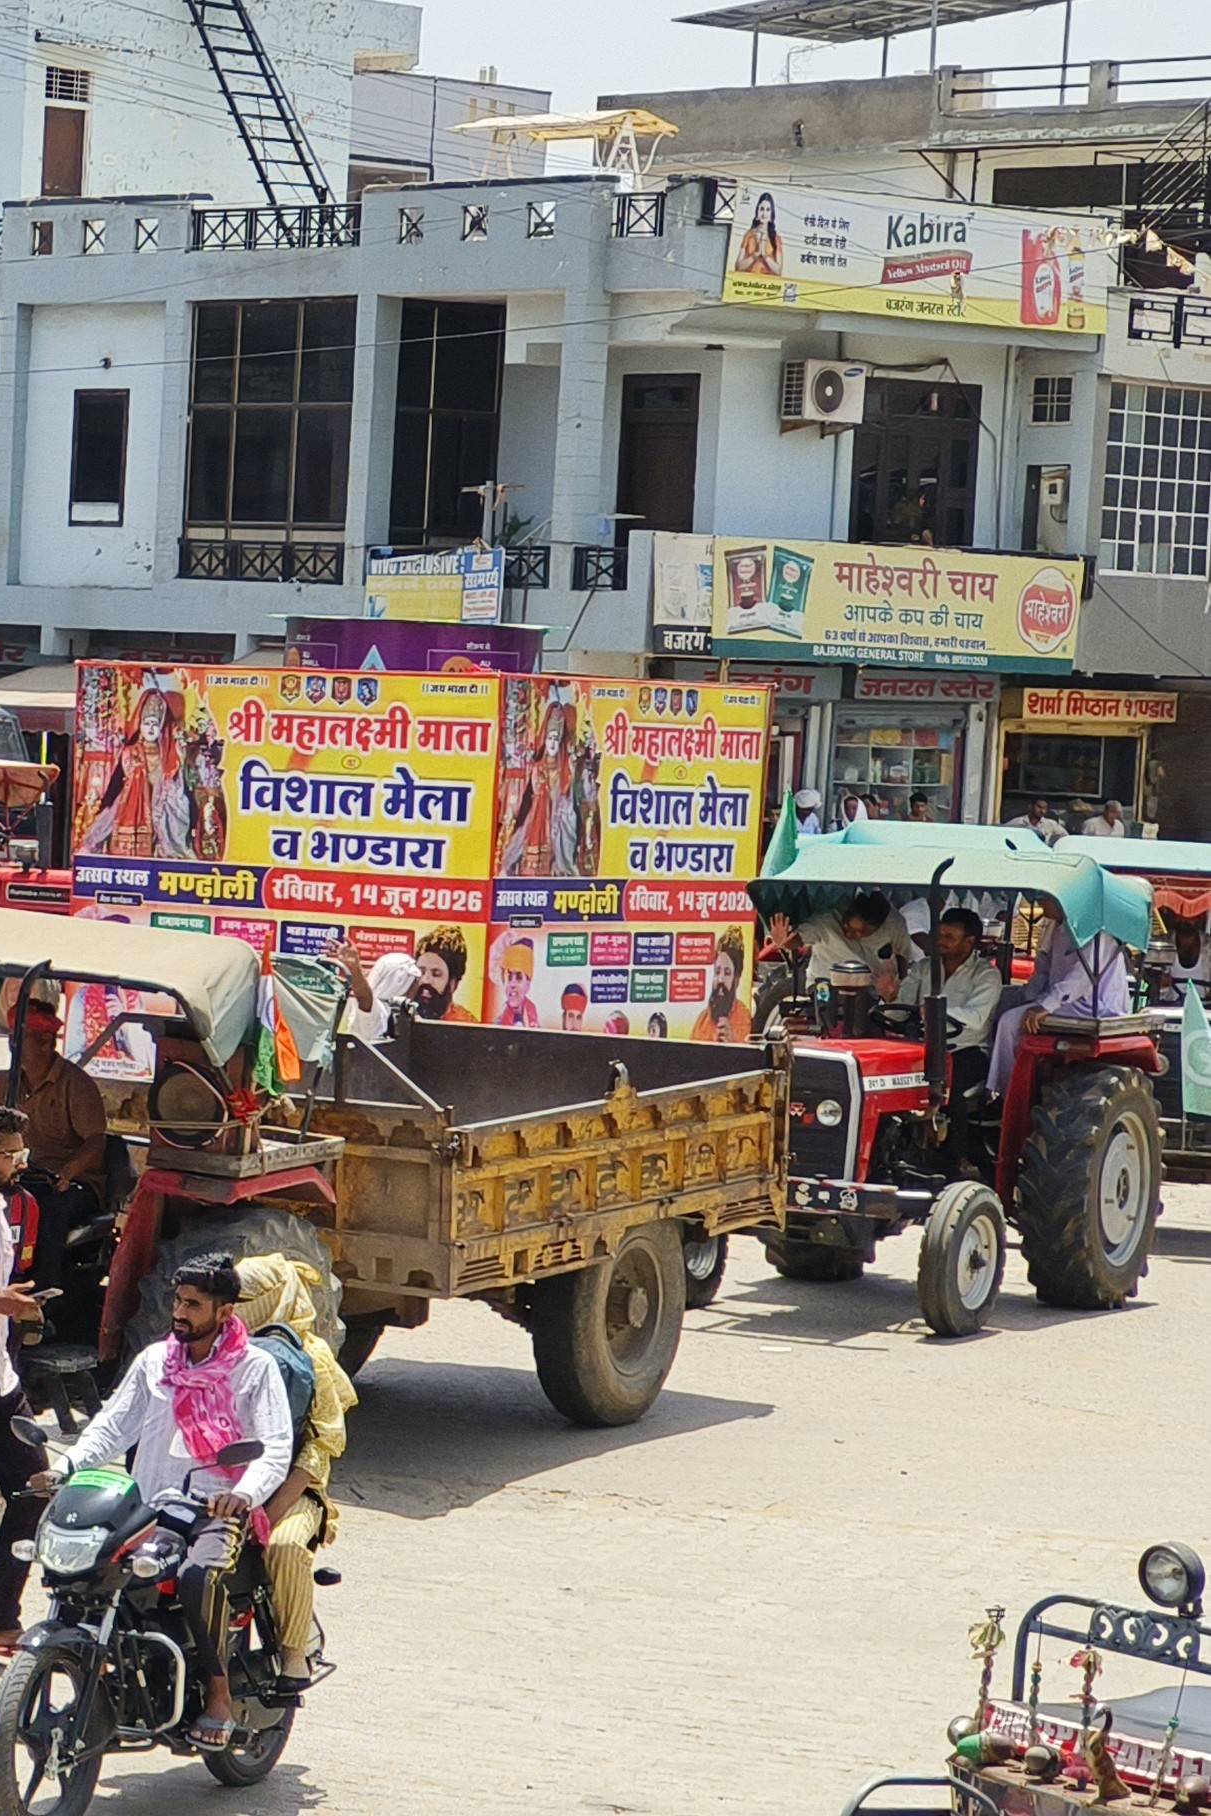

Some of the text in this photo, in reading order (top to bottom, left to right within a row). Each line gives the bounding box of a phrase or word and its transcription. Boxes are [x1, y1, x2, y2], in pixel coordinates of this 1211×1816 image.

[886, 212, 967, 250] Kabira
[887, 259, 967, 280] Yellow Mustard Oil
[885, 297, 966, 317] बजरंग जनरल स्टो
[371, 558, 398, 575] VIVO
[834, 552, 998, 603] माहेश्वरी चाय
[844, 600, 983, 630] आपके कप की चाय
[1024, 591, 1070, 626] माहेश्वरी
[663, 627, 706, 651] बजरंग
[813, 645, 856, 659] BAJRANG
[857, 647, 897, 662] GENERAL
[898, 649, 925, 662] STORE
[215, 676, 259, 687] जय माता दी
[430, 684, 479, 695] जय माता दी
[860, 675, 938, 698] जनरल
[940, 674, 996, 699] स्टोर
[1027, 688, 1176, 719] शर्मा मिष्ठान भण्डार
[229, 700, 492, 753] श्री महालक्ष्मी माता
[605, 711, 762, 763] श्री महालक्ष्मी माता
[240, 760, 472, 822] विशाल मेला
[610, 772, 750, 827] विशाल मेला
[272, 829, 446, 869] व भण्डारा
[629, 841, 735, 873] व भण्डारा
[76, 866, 114, 885] उत्सव
[115, 868, 150, 887] स्थल
[272, 874, 483, 915] रविवार, 14 जून 2026
[497, 890, 523, 907] उत्सव
[524, 890, 548, 907] स्थल
[629, 889, 673, 915] रविवार,
[677, 891, 692, 912] 14
[694, 892, 717, 918] जून
[892, 1076, 913, 1086] MASSEY
